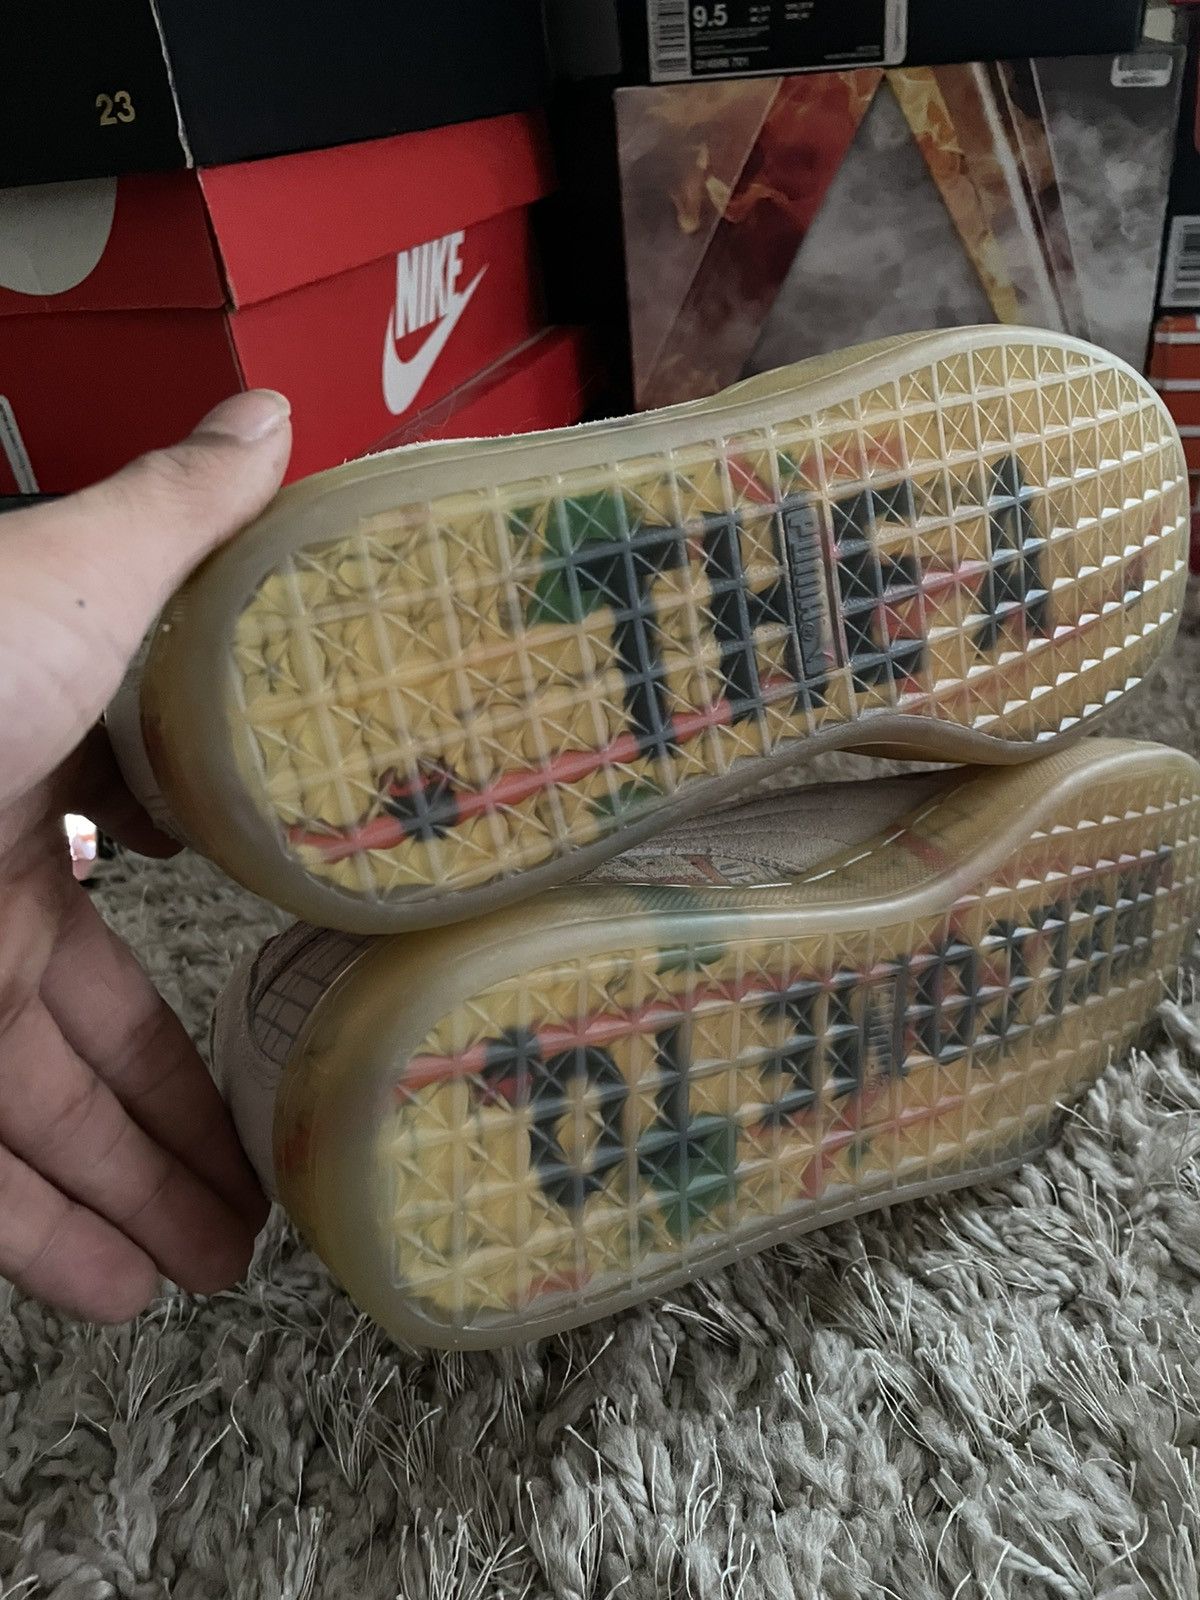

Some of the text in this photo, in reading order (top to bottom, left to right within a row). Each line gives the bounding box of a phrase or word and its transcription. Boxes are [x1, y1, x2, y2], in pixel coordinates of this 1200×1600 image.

[693, 4, 728, 28] 9.5
[95, 91, 136, 126] 23
[395, 229, 466, 340] NIKE
[789, 516, 823, 622] PUMA
